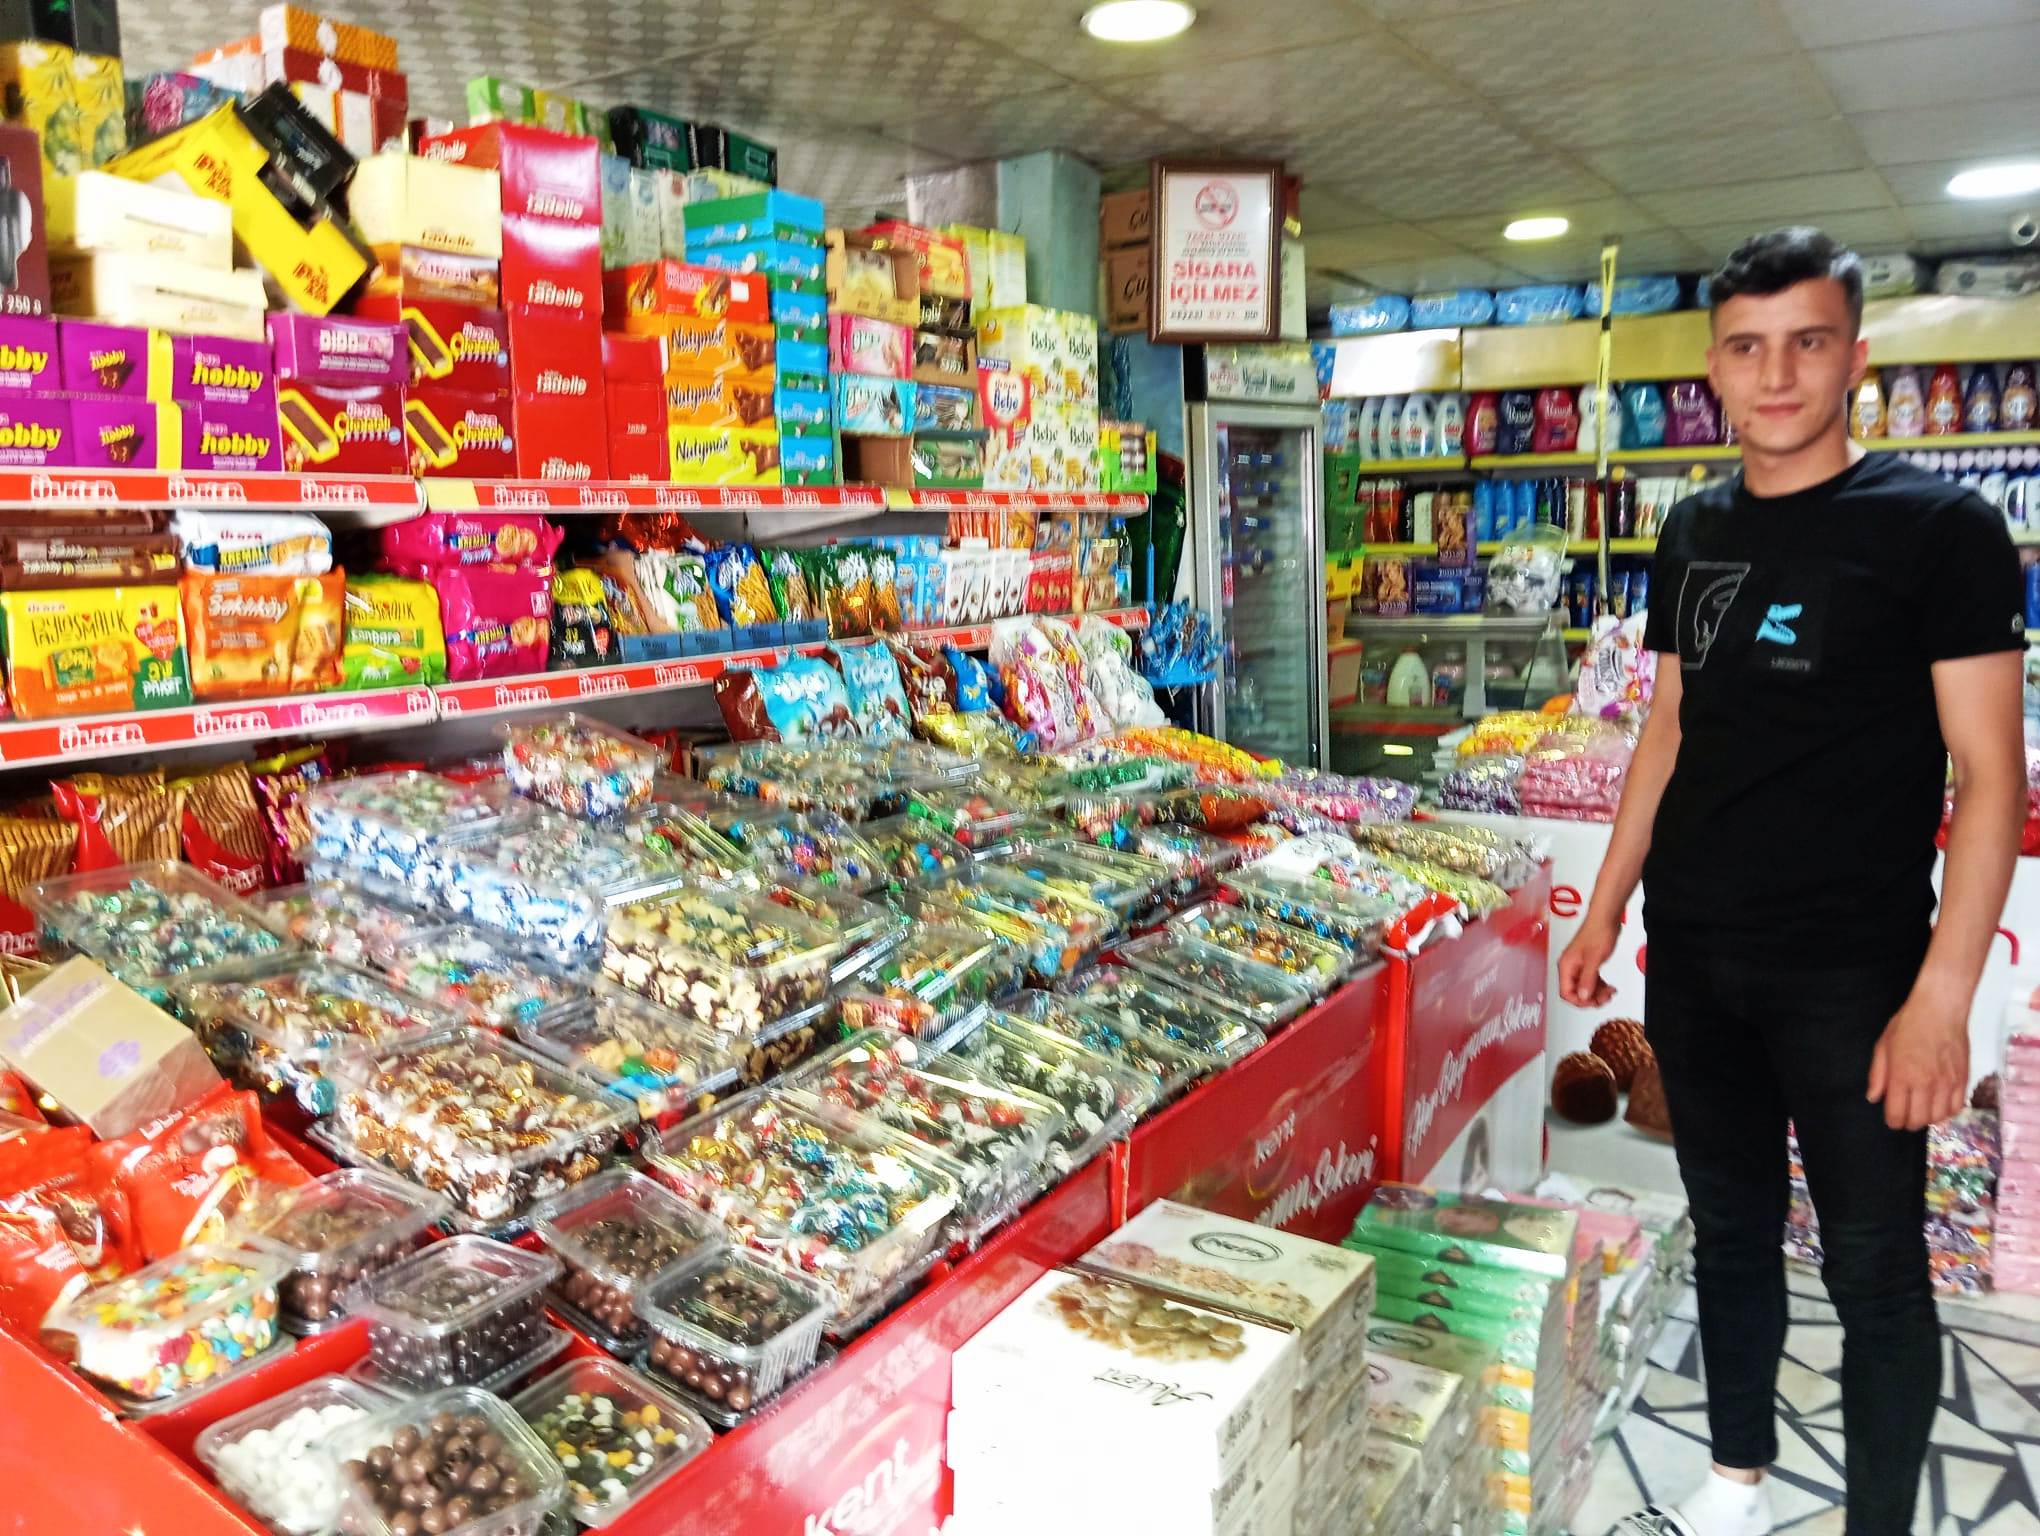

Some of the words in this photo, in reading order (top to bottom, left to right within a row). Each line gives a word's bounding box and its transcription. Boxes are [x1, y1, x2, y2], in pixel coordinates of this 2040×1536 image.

[1173, 257, 1257, 281] SİGARA
[1169, 280, 1260, 305] İÇİLMEZ
[192, 363, 264, 393] hobby
[200, 432, 271, 459] hobby
